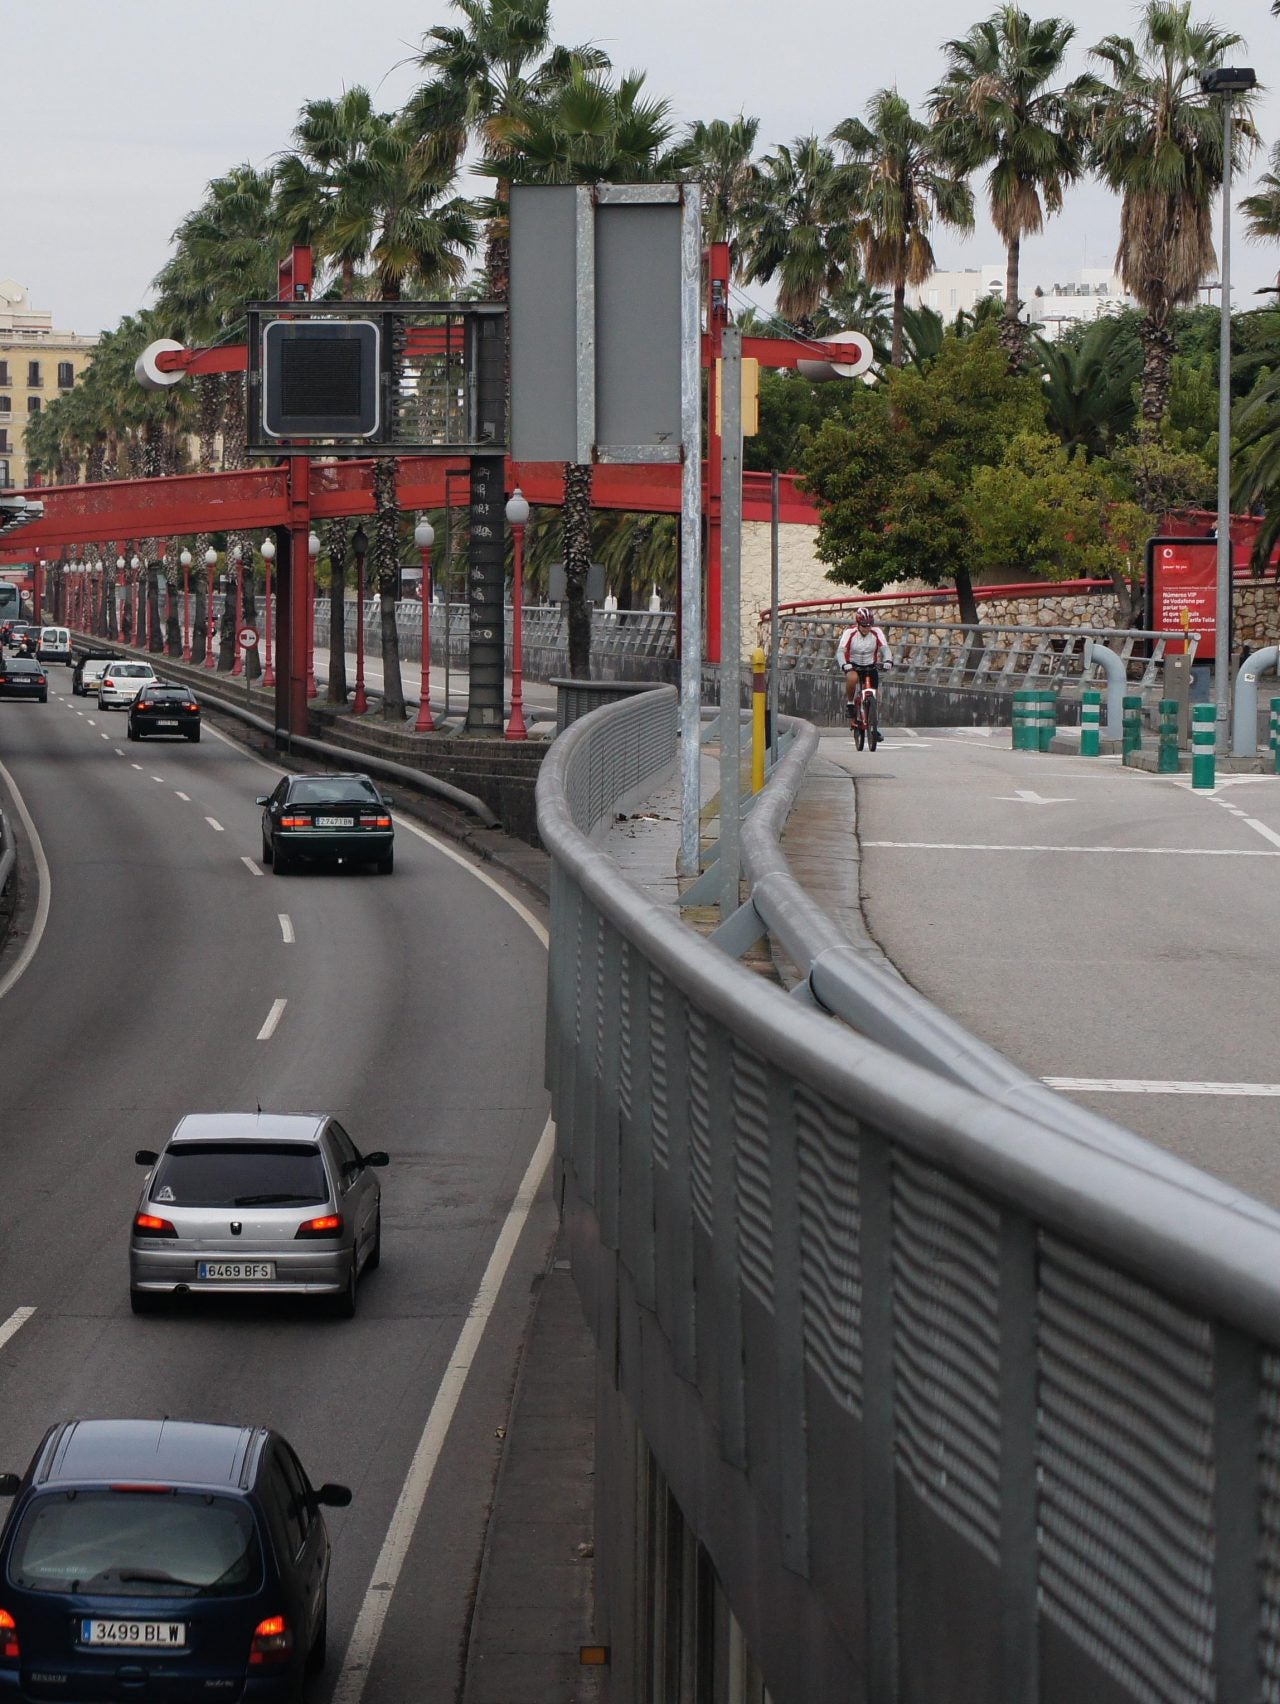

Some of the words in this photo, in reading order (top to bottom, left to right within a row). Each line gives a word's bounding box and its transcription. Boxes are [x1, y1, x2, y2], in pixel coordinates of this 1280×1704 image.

[208, 1265, 241, 1277] 6469
[244, 1265, 268, 1278] BFS
[96, 1623, 140, 1641] 3499
